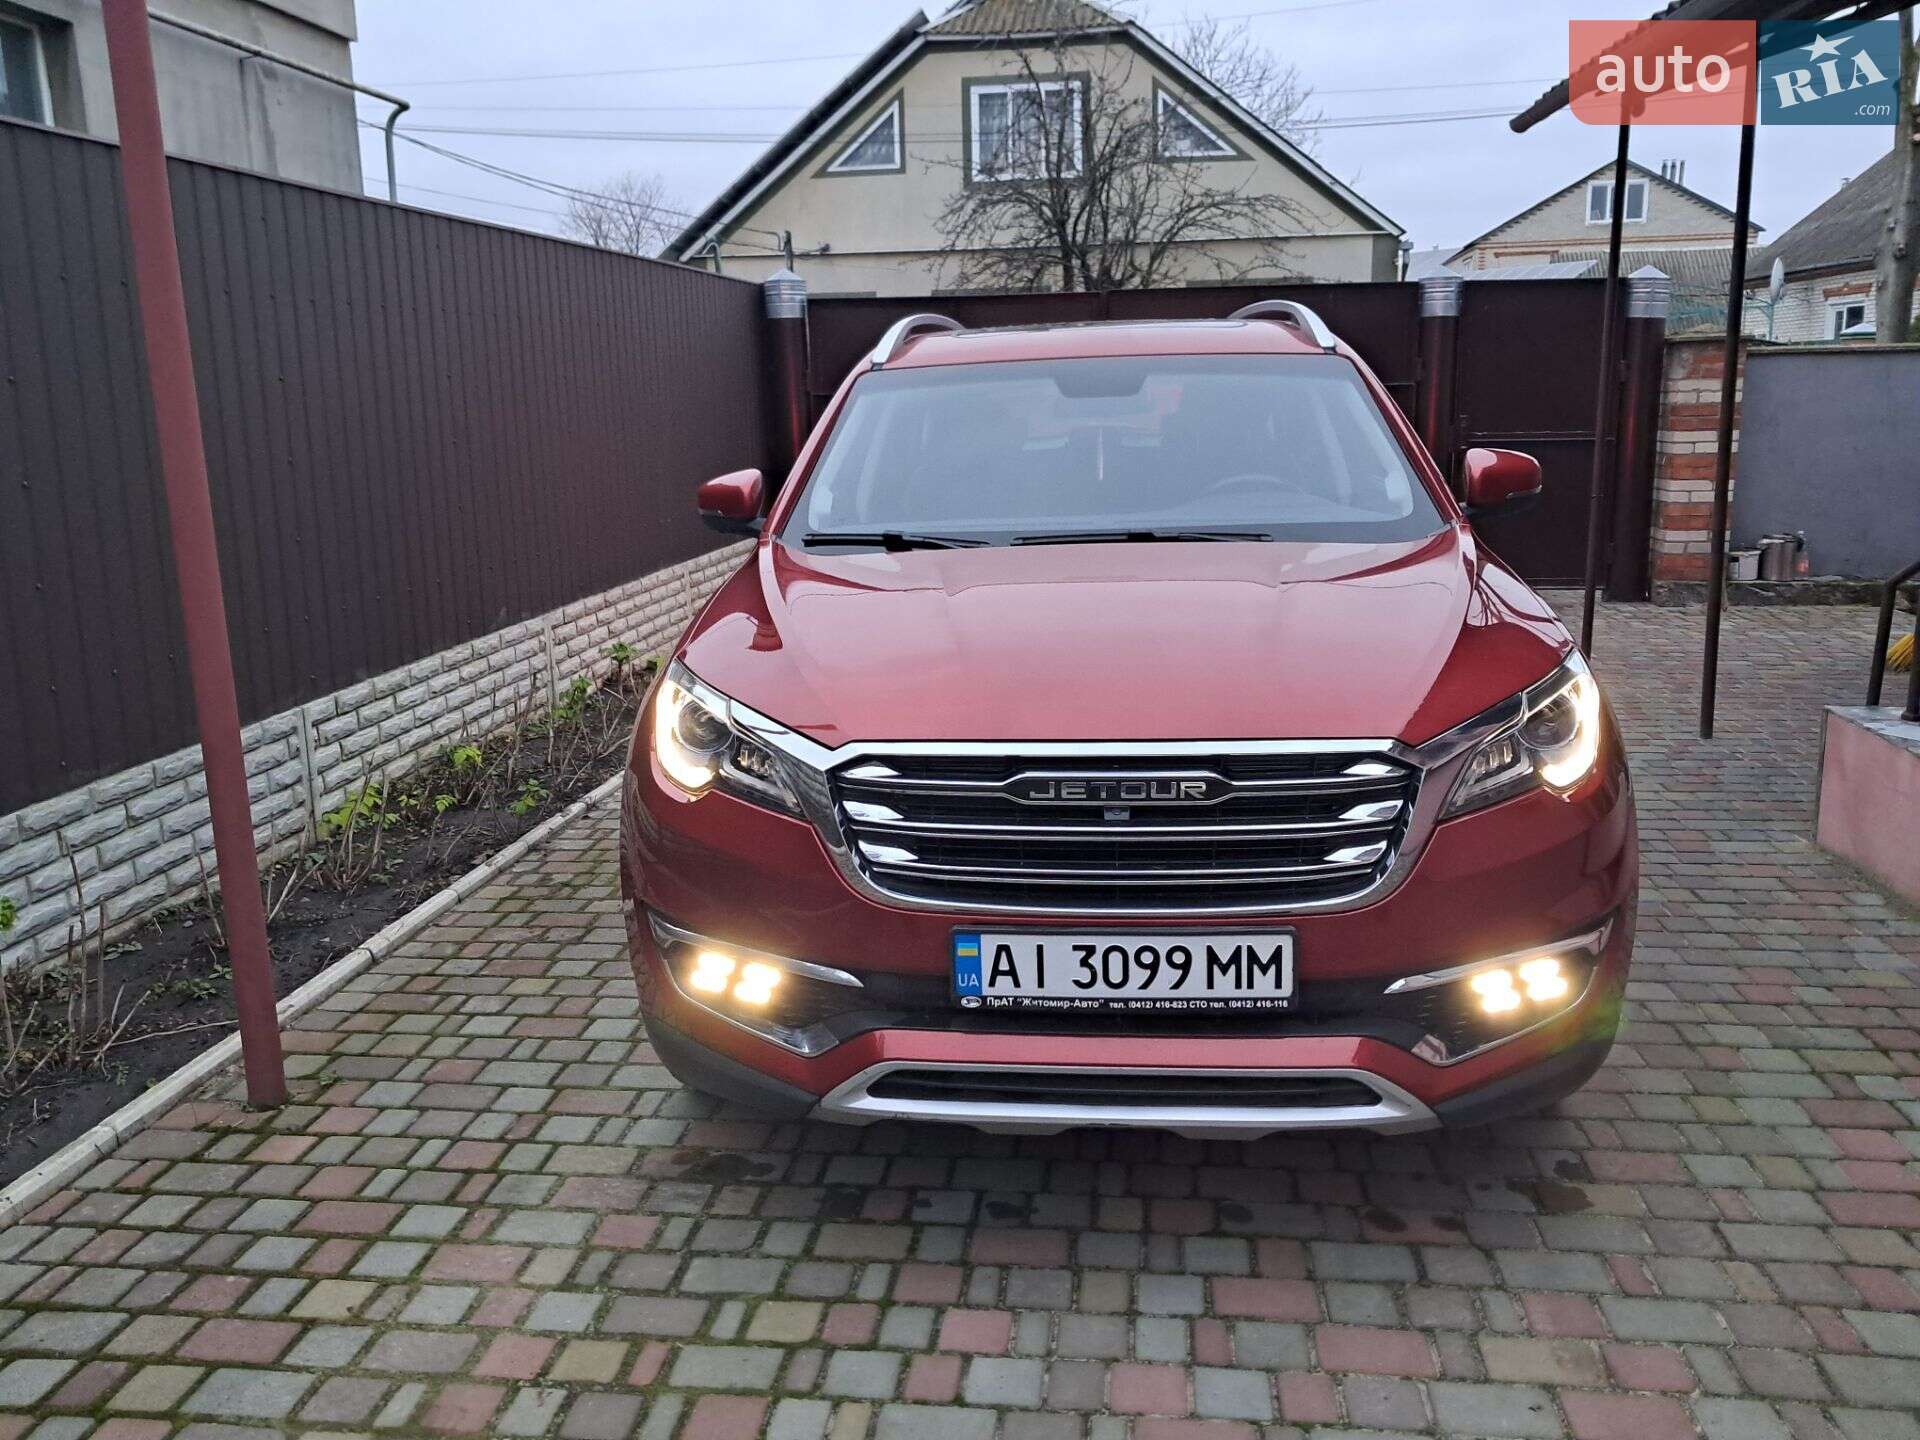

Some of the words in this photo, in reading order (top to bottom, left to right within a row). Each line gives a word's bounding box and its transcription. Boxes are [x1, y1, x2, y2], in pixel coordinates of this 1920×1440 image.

[1030, 781, 1207, 799] JETOUR
[1071, 944, 1193, 990] 3099
[1206, 944, 1283, 990] MM
[958, 974, 979, 988] UA
[986, 997, 1015, 1008] ПрАТ
